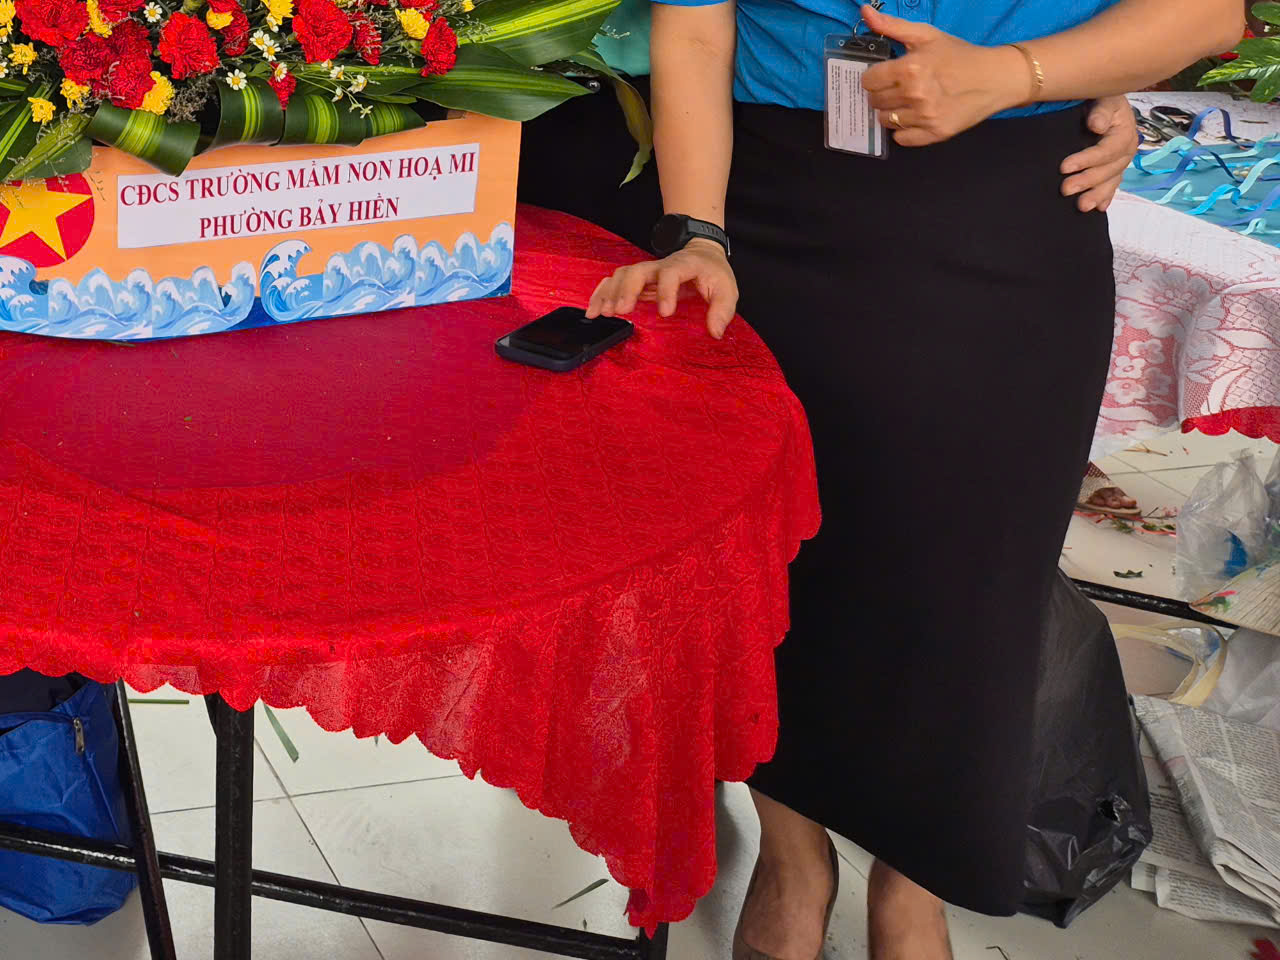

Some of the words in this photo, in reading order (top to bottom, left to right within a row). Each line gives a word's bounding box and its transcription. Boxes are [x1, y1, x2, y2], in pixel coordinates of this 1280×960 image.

[120, 180, 180, 207] CĐCS
[186, 168, 280, 201] TRƯỜNG
[347, 159, 393, 183] NON
[398, 155, 443, 181] HOẠ
[448, 151, 476, 173] MI
[199, 205, 293, 238] PHƯỜNG
[299, 198, 343, 228] BẢY
